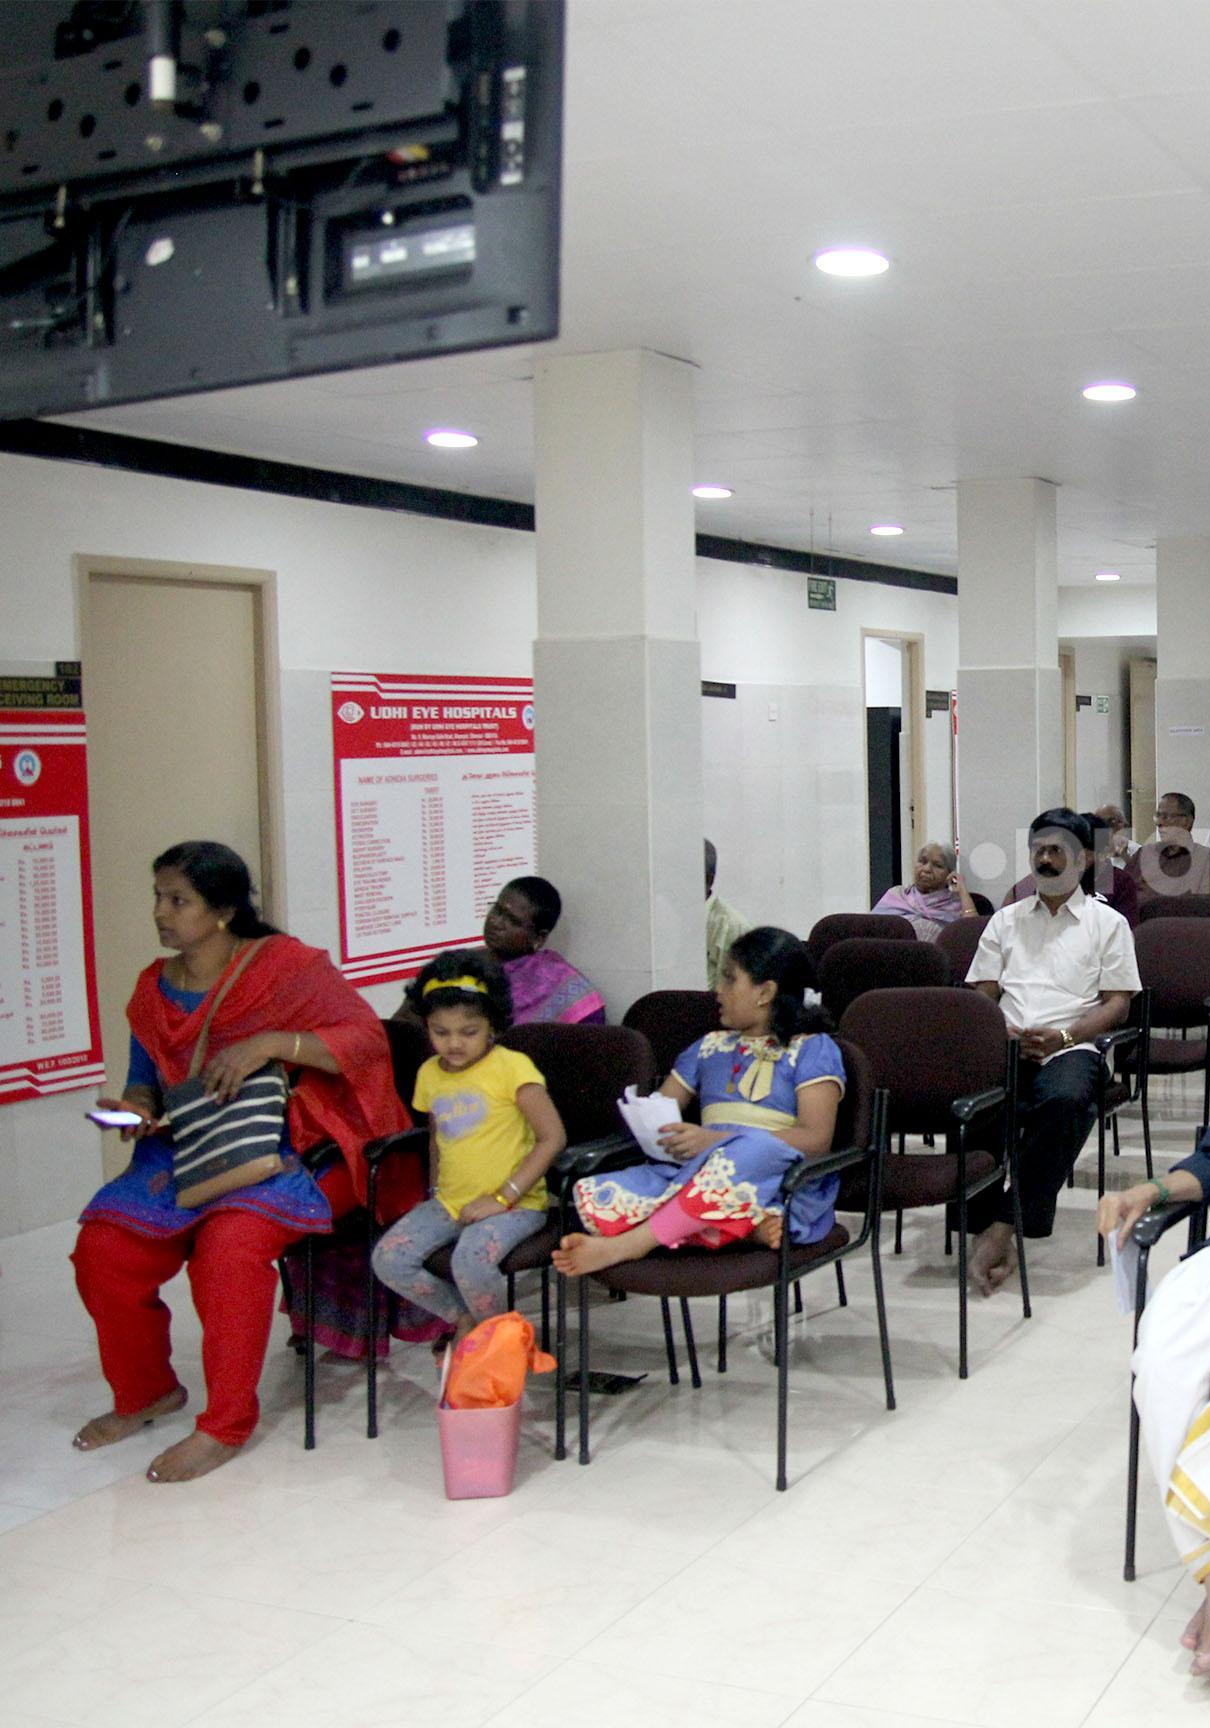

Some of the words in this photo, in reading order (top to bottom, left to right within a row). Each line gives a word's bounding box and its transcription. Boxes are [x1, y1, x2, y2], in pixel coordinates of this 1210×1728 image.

[369, 706, 408, 719] UDHI
[412, 706, 440, 719] EYE
[442, 706, 517, 719] HOSPITALS
